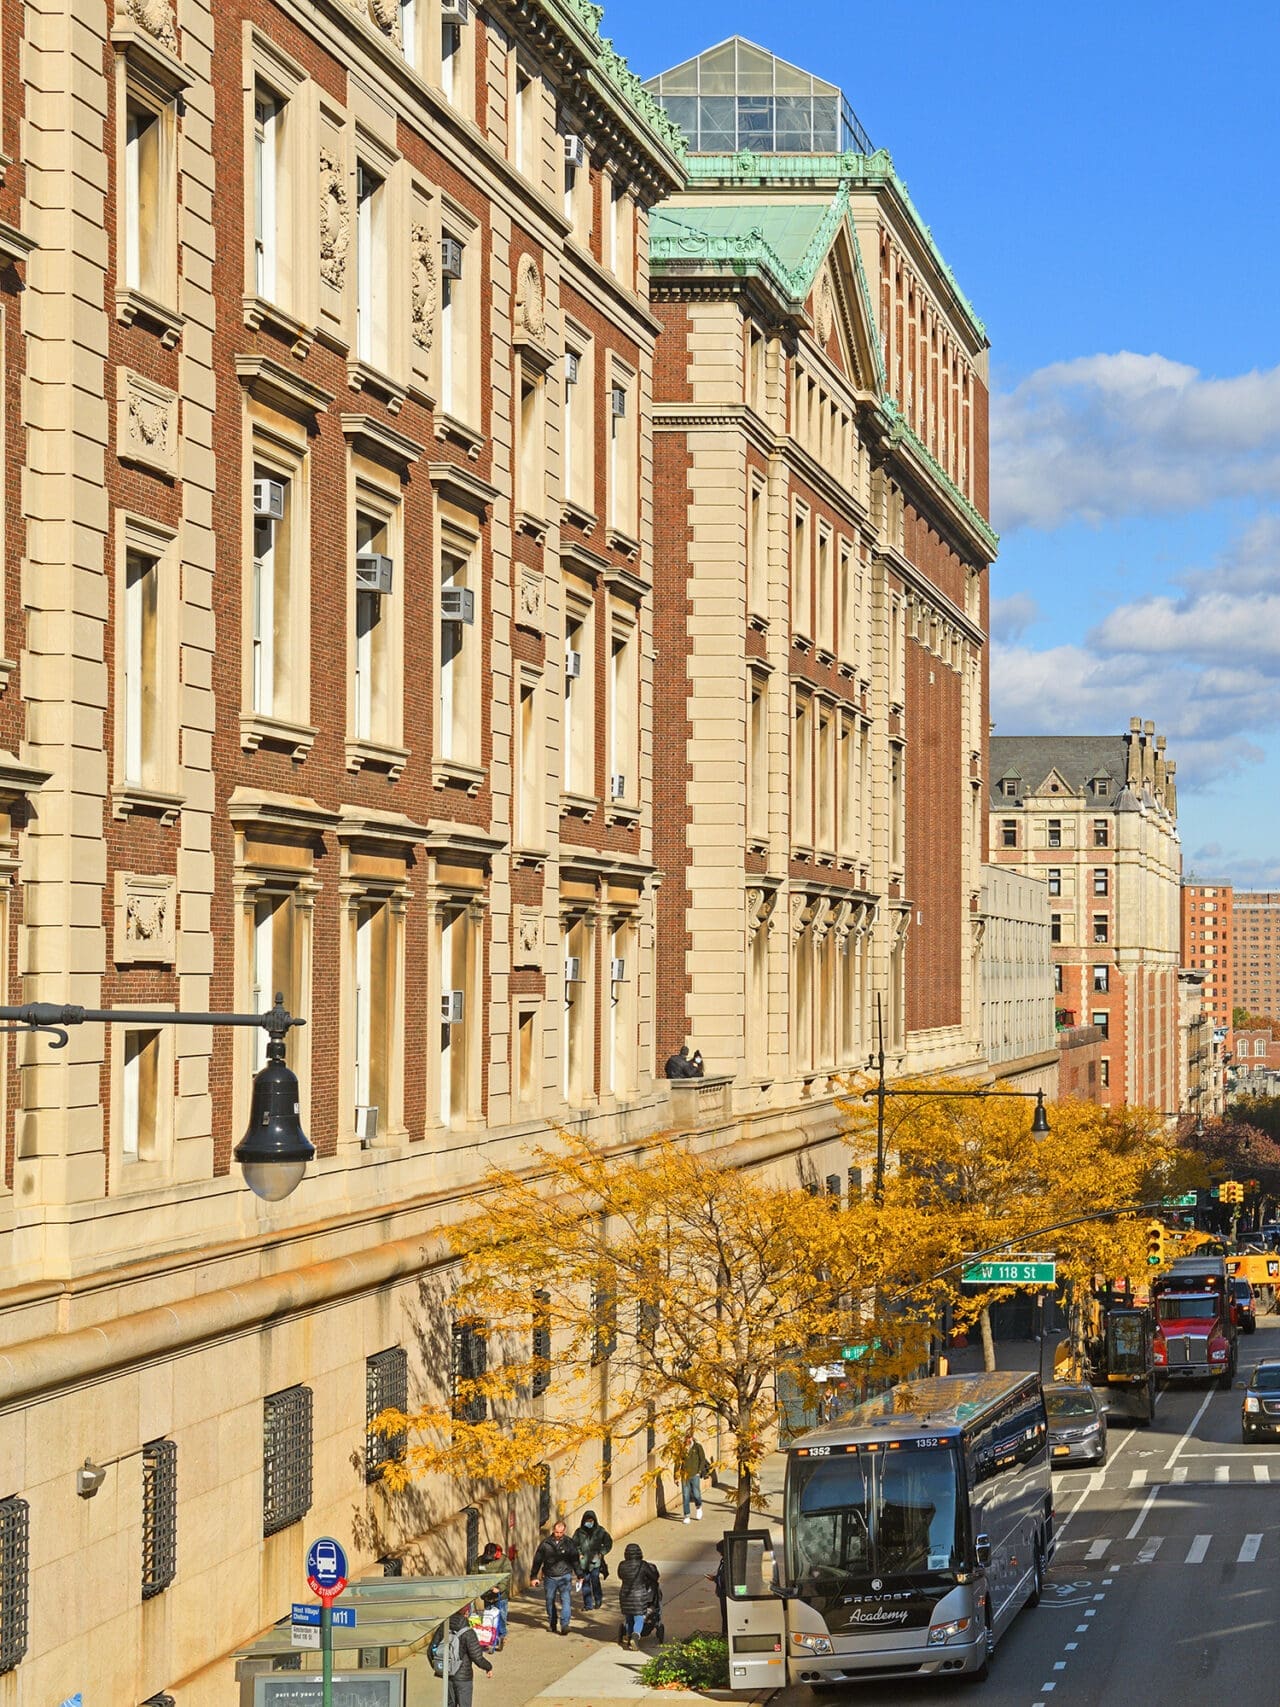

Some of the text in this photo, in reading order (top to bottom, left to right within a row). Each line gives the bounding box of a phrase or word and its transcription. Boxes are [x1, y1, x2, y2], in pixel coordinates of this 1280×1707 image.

[982, 1266, 1036, 1279] W 118 St
[917, 1438, 938, 1448] 1352
[808, 1446, 831, 1457] 1352
[310, 1580, 344, 1596] NO STANDING
[843, 1592, 912, 1604] PREVOST
[332, 1610, 348, 1625] M11
[849, 1606, 909, 1624] Academy
